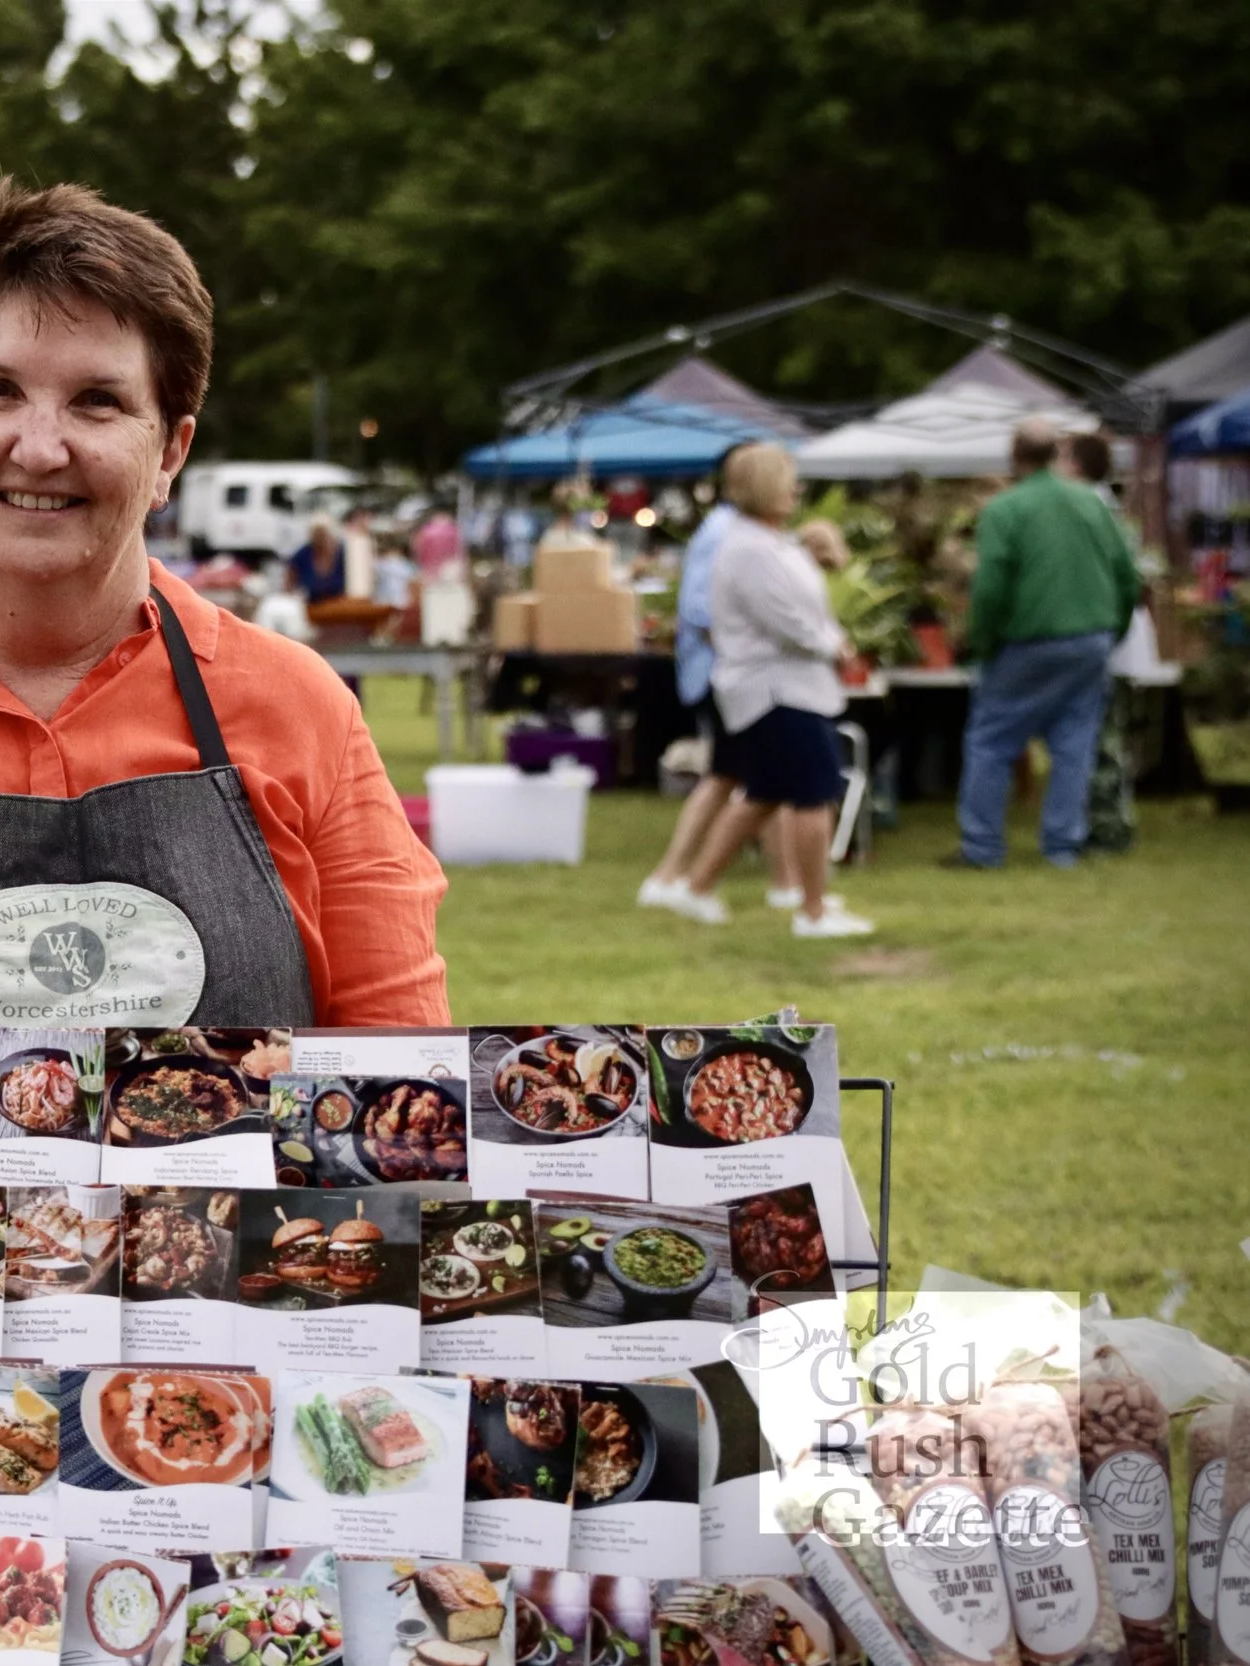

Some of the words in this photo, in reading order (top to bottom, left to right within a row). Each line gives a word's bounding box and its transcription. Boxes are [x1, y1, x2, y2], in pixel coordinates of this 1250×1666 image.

[63, 896, 138, 920] LOVED
[7, 1157, 36, 1167] Nomads
[172, 1158, 189, 1166] Spice
[536, 1160, 554, 1169] Spice
[556, 1160, 585, 1168] Nomads
[717, 1163, 737, 1171] Spice
[739, 1163, 771, 1171] Nomads
[19, 1168, 36, 1176] Spice
[38, 1169, 56, 1177] Blend
[221, 1167, 238, 1175] Spice
[576, 1169, 593, 1178] Spice
[764, 1173, 783, 1181] Spice
[12, 1318, 29, 1327] Spice
[31, 1318, 59, 1326] Nomads
[134, 1317, 151, 1327] Spice
[152, 1319, 180, 1327] Nomads
[52, 1327, 68, 1336] Spice
[161, 1328, 177, 1336] Spice
[303, 1324, 322, 1334] Spice
[323, 1326, 354, 1334] Nomads
[436, 1338, 455, 1347] Spice
[611, 1343, 631, 1353] Spice
[633, 1344, 666, 1352] Nomads
[657, 1354, 677, 1362] Spice
[133, 1495, 155, 1506] Spice
[165, 1496, 177, 1508] Up
[129, 1508, 148, 1517] Spice
[150, 1510, 181, 1519] Nomads
[100, 1517, 120, 1525] Indian
[122, 1518, 141, 1526] Butter
[143, 1520, 169, 1528] Chicken
[171, 1521, 189, 1530] Spice
[191, 1522, 210, 1531] Blend
[340, 1515, 358, 1523] Spice
[359, 1516, 388, 1525] Nomads
[523, 1536, 543, 1547] Blend
[1113, 1533, 1134, 1548] TEX
[1137, 1533, 1161, 1548] MEX
[1108, 1549, 1145, 1564] CHILLI
[1147, 1549, 1166, 1564] MIX
[936, 1568, 950, 1584] EF
[1015, 1570, 1034, 1587] TEX
[1036, 1564, 1065, 1581] MEX
[973, 1579, 994, 1594] MIX
[1014, 1583, 1048, 1603] CHILLI
[1049, 1578, 1075, 1596] MIX
